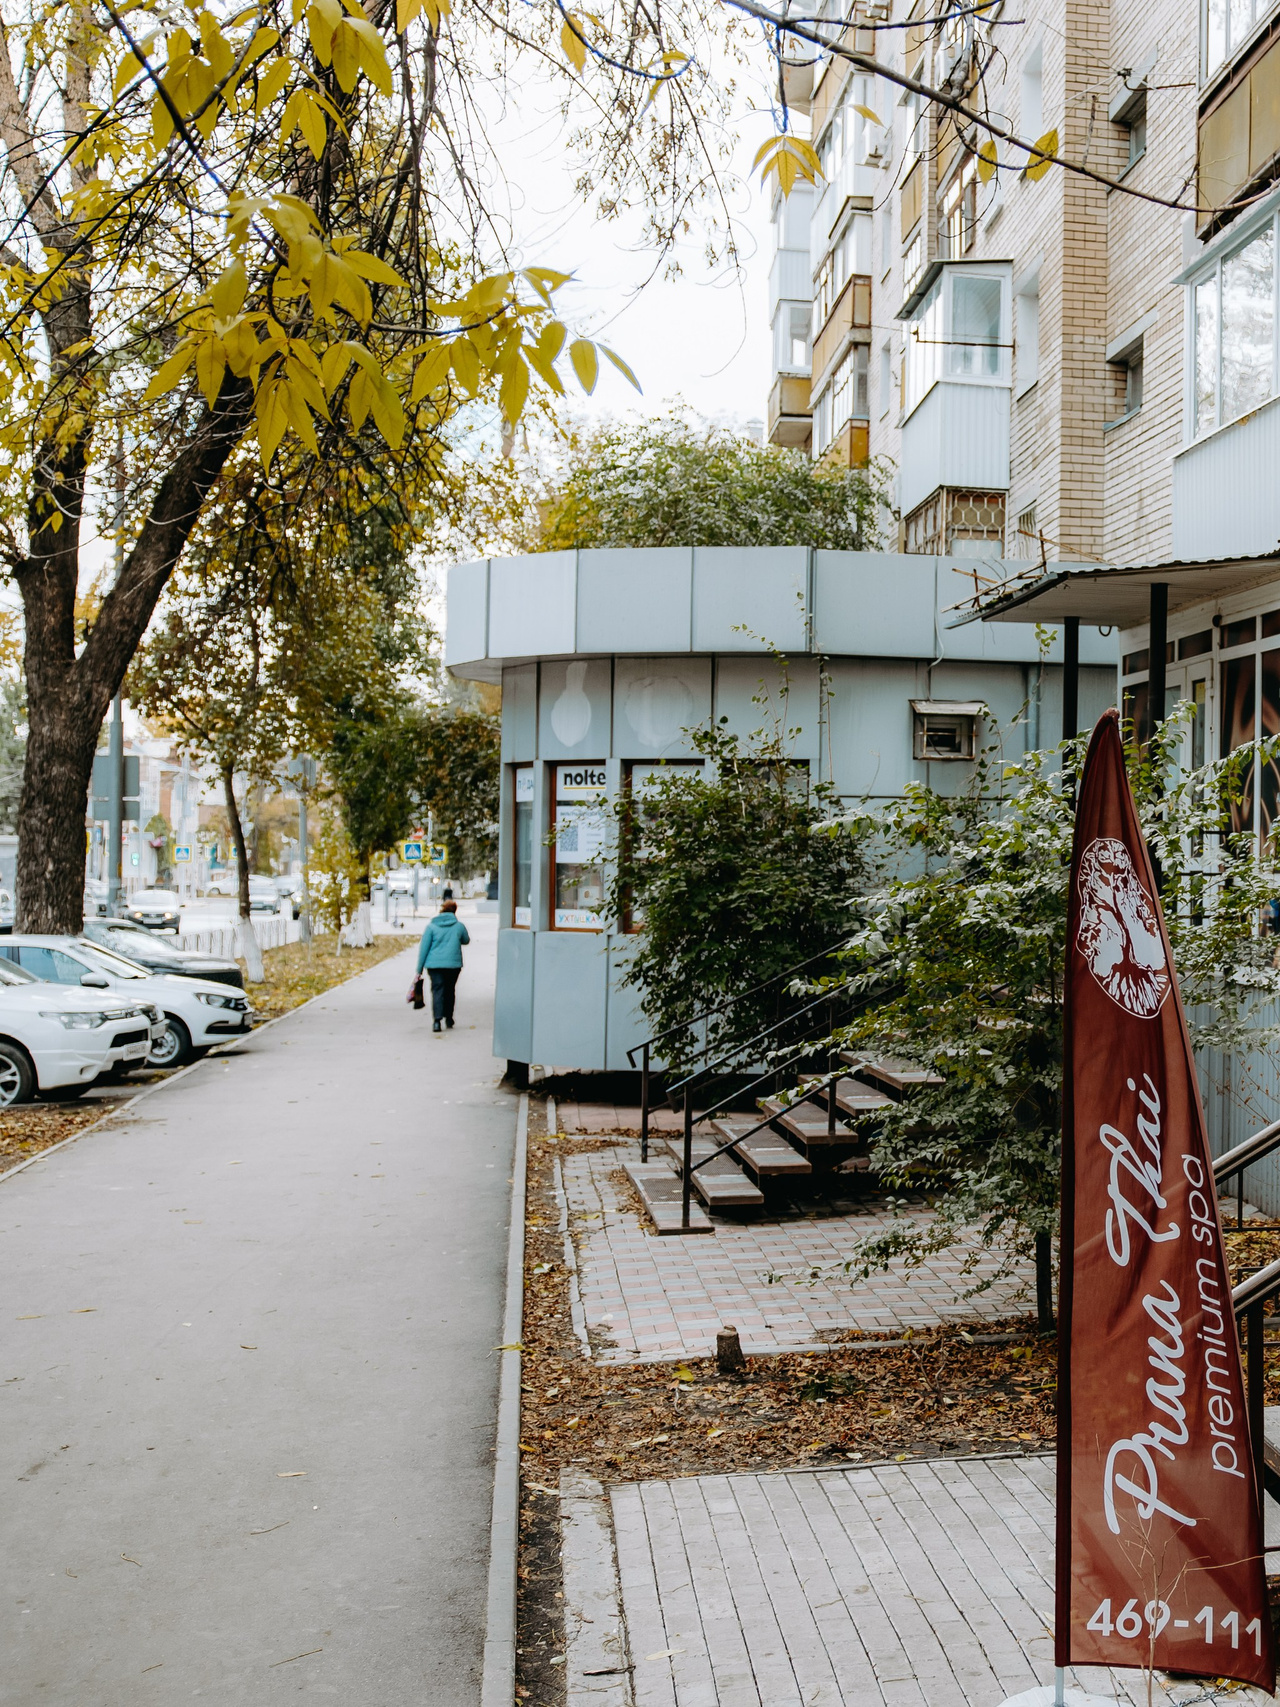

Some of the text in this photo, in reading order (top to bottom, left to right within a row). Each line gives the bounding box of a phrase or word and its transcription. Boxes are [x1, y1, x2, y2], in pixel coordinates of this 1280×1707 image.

[563, 769, 606, 786] nolte
[1099, 1072, 1197, 1535] Prana Thai
[1181, 1154, 1246, 1479] premium spa
[1086, 1598, 1263, 1657] 469-111
